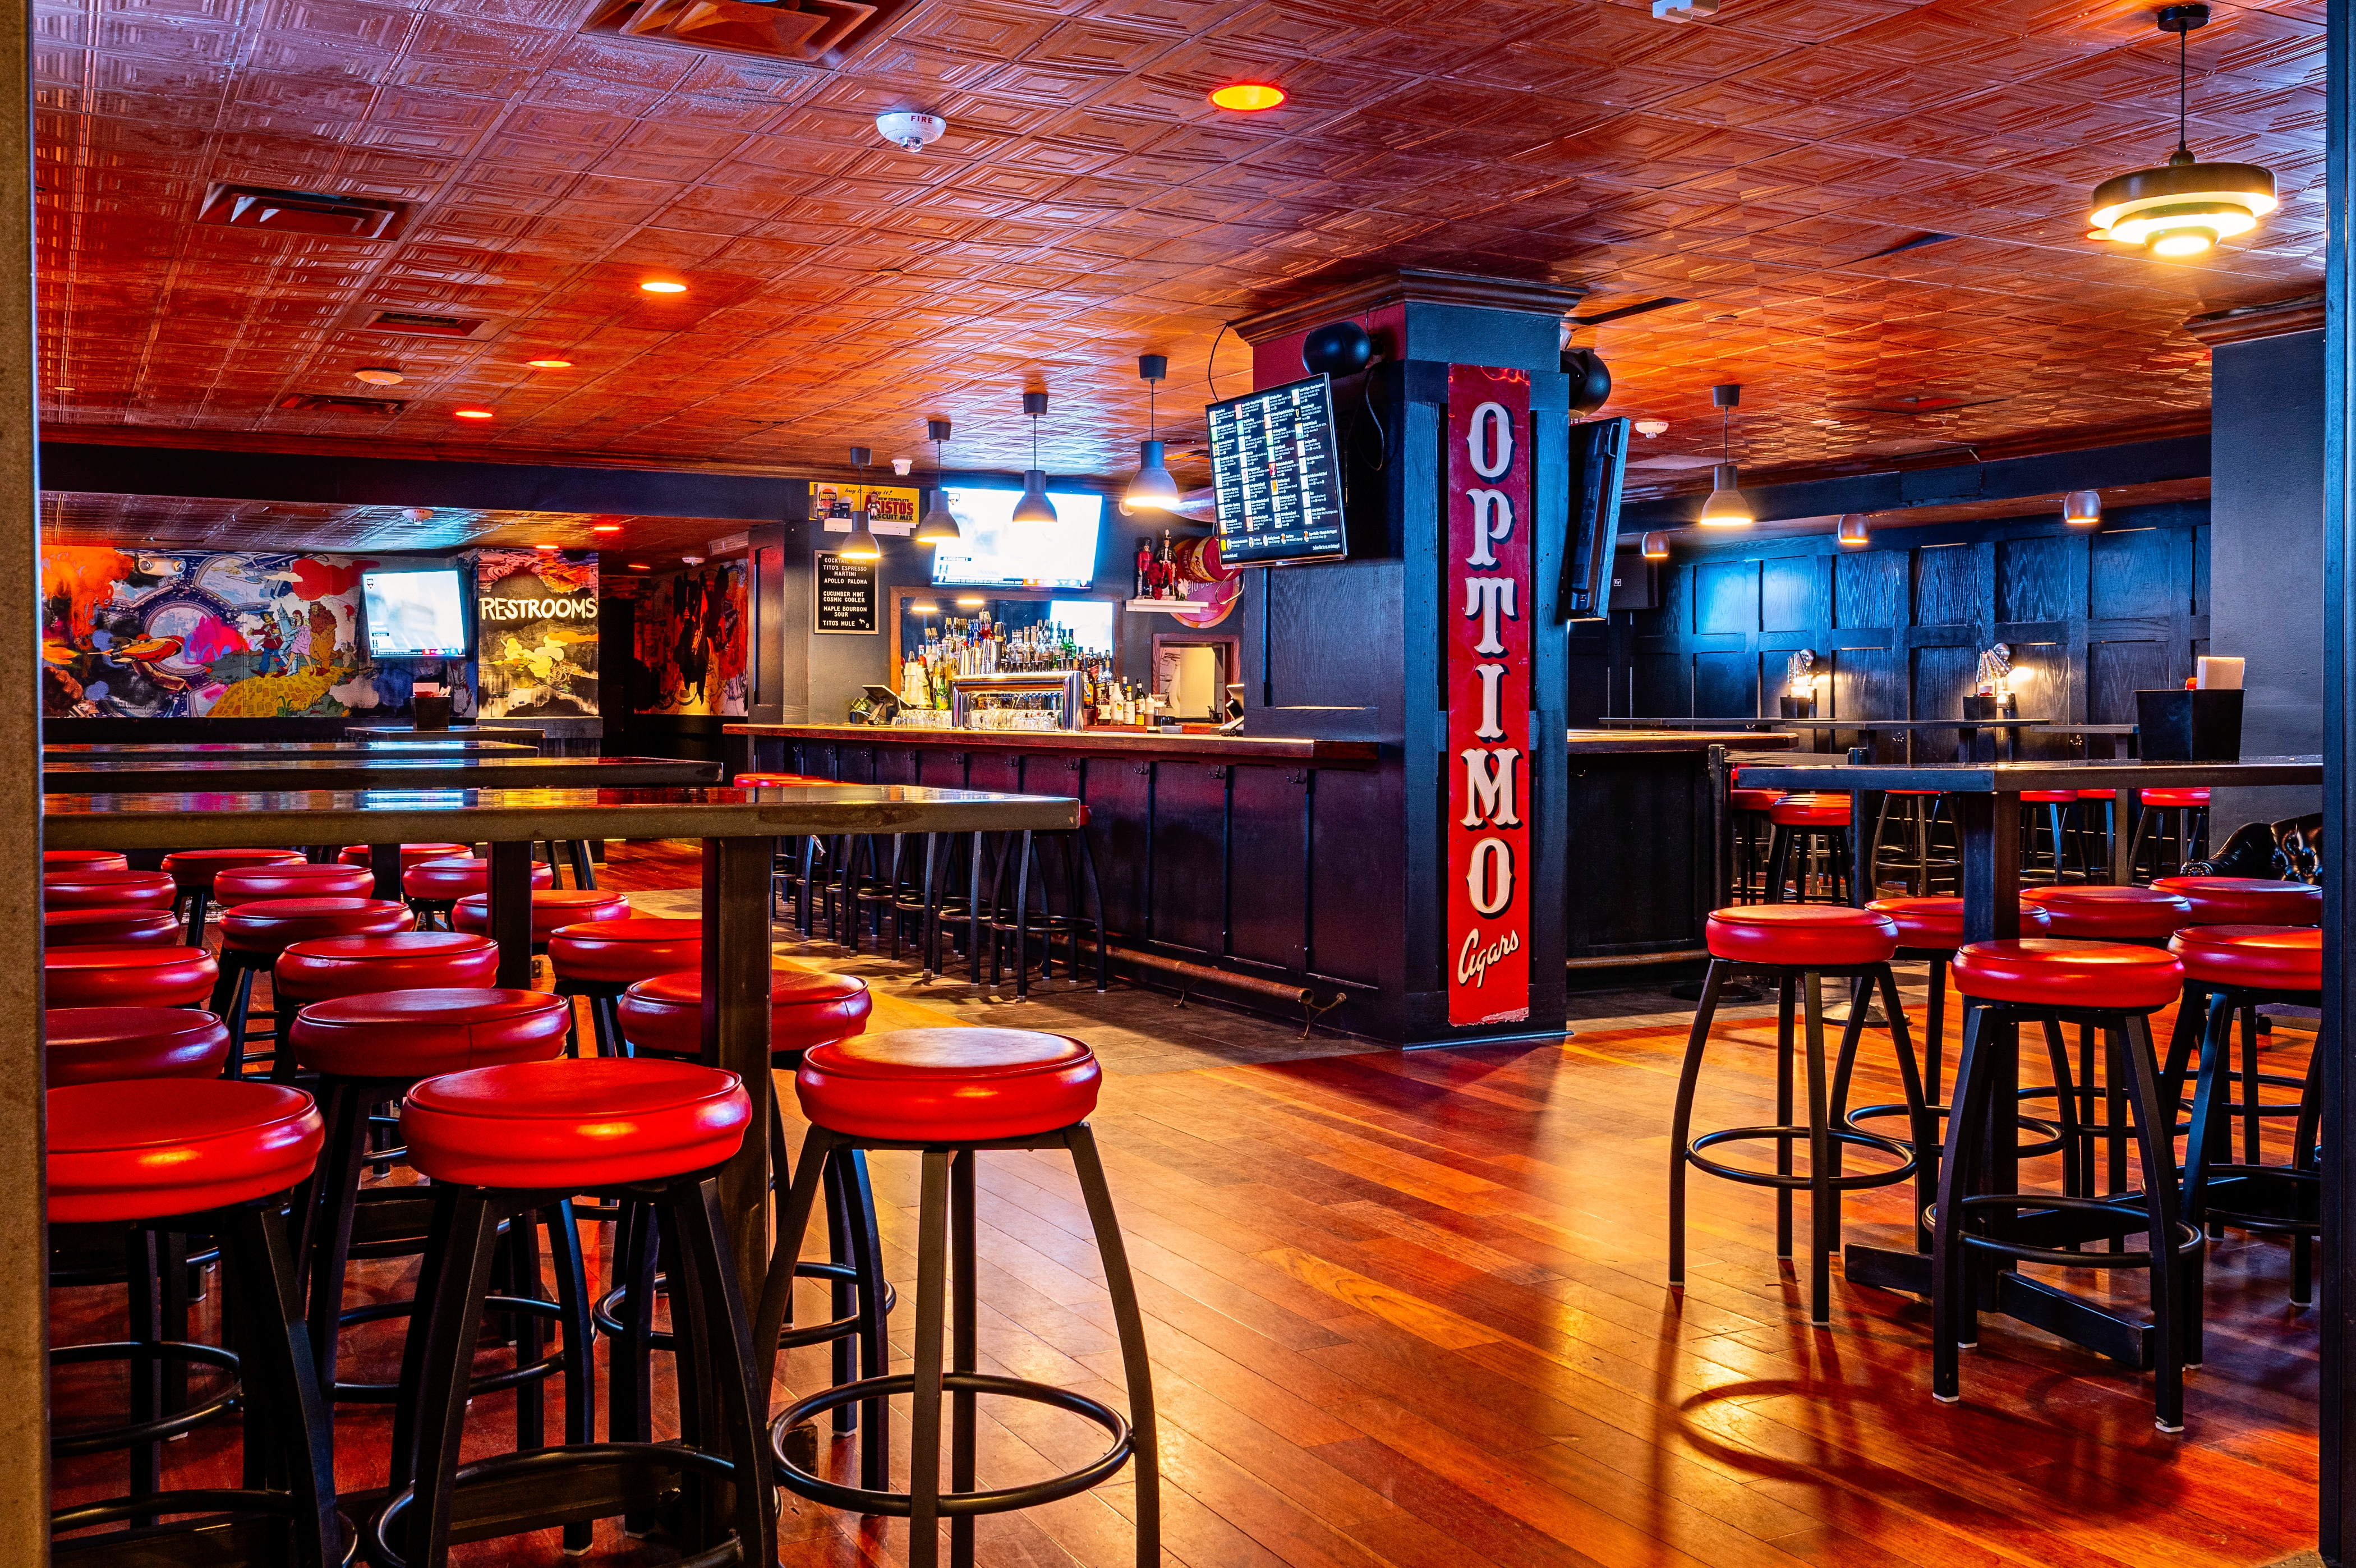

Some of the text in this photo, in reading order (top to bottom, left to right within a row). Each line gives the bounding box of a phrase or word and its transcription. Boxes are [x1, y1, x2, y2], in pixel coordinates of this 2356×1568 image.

[910, 115, 933, 124] FIRE
[820, 490, 836, 501] ARISTOS
[478, 597, 599, 620] RESTROOMS
[1460, 401, 1521, 917] OPTIMO
[1457, 928, 1520, 988] Cigars
